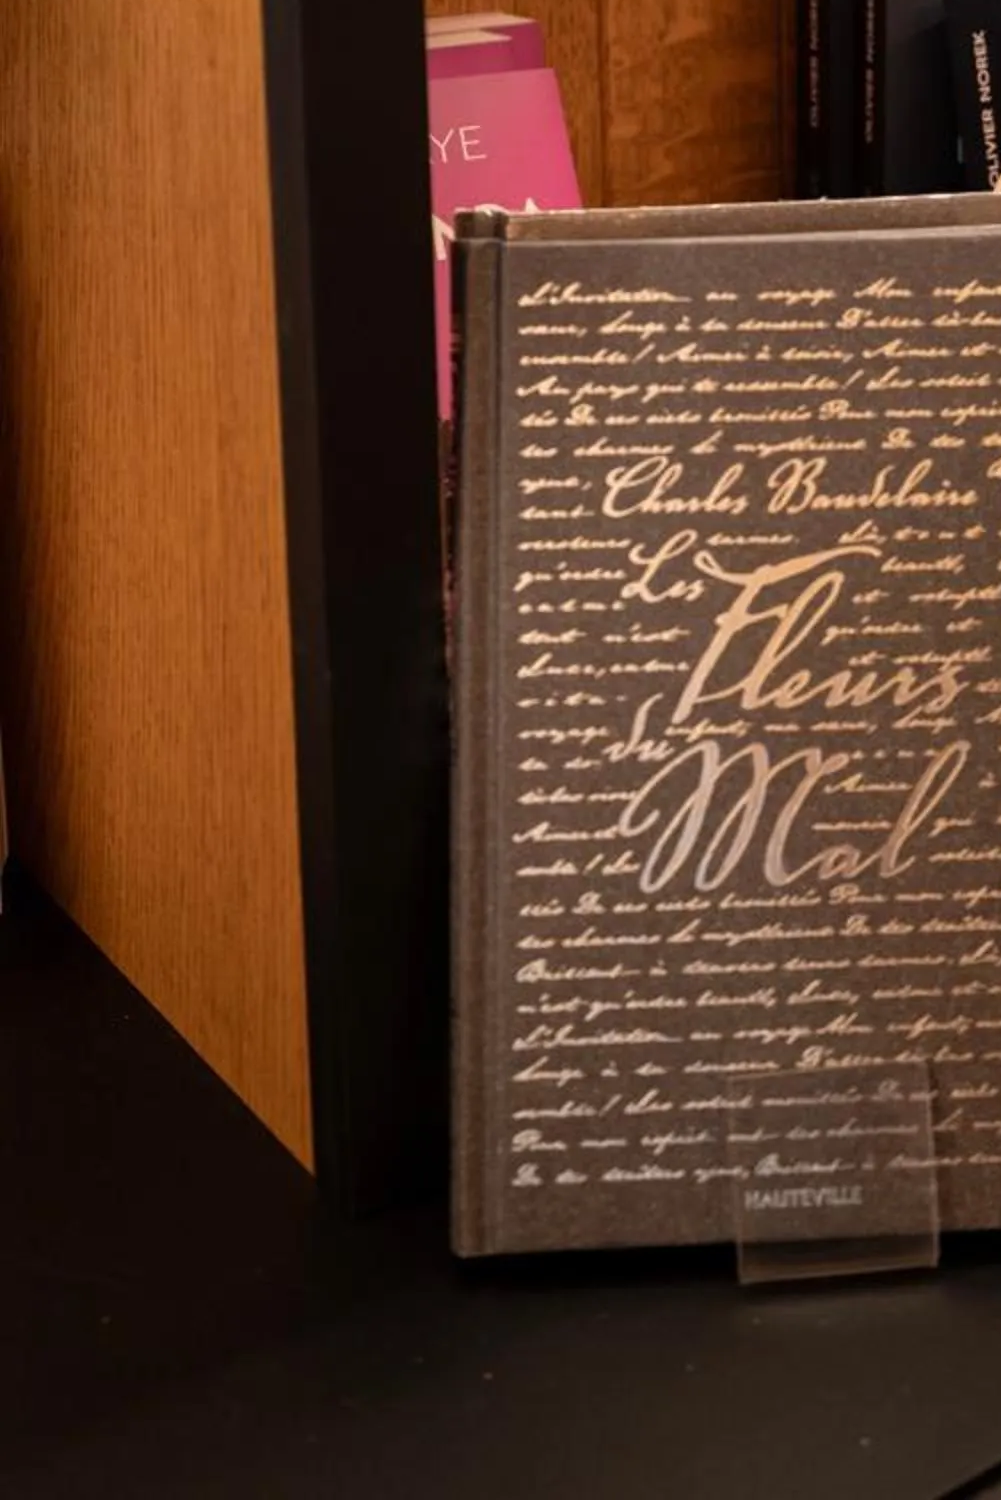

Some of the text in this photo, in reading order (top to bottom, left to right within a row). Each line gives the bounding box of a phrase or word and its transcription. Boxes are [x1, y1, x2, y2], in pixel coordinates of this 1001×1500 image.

[430, 125, 488, 163] YE
[970, 29, 1001, 187] OLIVIER NOREK
[603, 456, 749, 518] Charles
[767, 456, 979, 513] Baudelaire
[620, 529, 707, 603] Les
[671, 545, 969, 724] Fleurs
[618, 739, 916, 894] Mal
[745, 1185, 864, 1211] HAUTEVILLE
